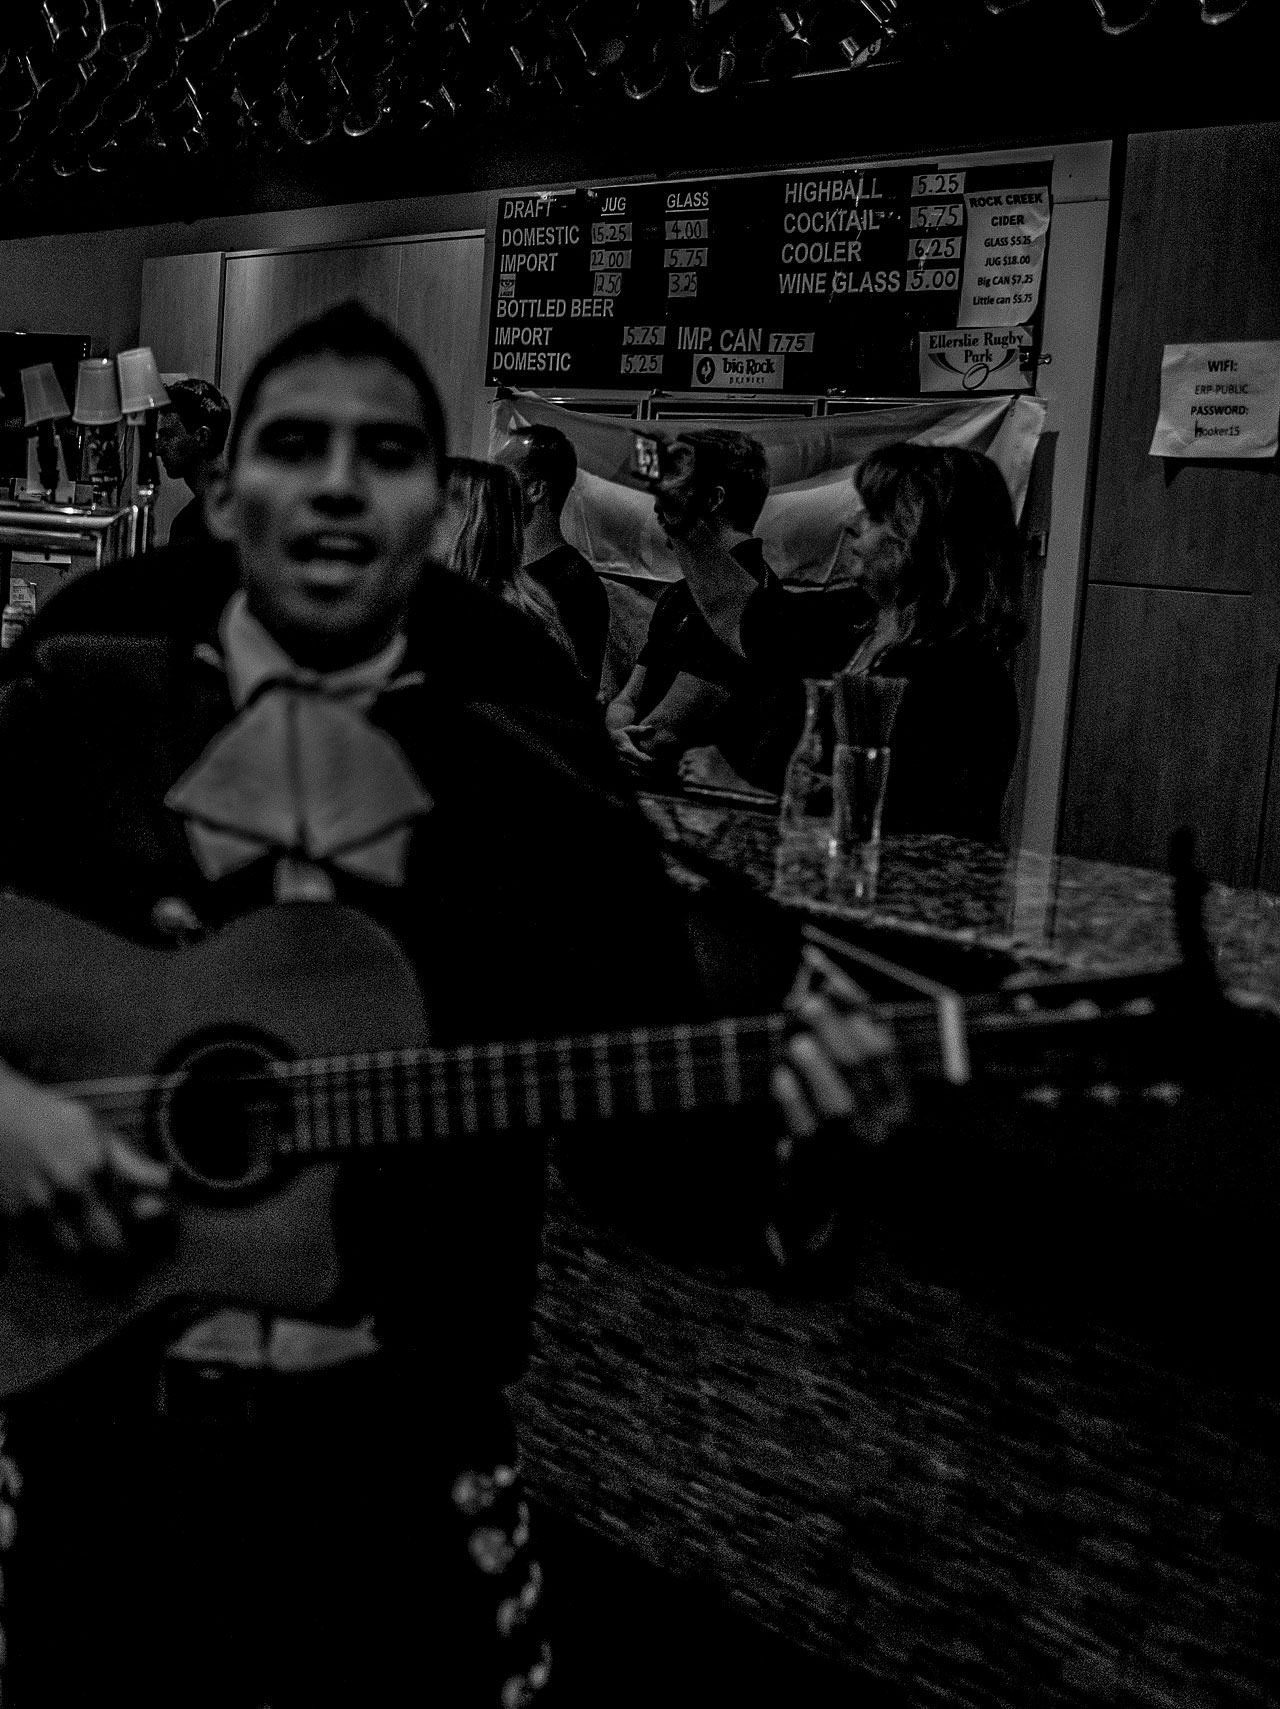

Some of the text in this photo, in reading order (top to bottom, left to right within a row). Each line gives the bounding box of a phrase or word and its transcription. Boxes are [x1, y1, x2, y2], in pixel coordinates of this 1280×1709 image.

[784, 178, 883, 203] HIGHBALL
[918, 175, 960, 194] 5.25
[504, 199, 554, 219] DRAFT
[602, 196, 626, 213] JUG
[666, 192, 709, 208] GLASS
[969, 194, 1042, 207] ROCK CREEK
[784, 209, 880, 233] COCKTAIL
[917, 206, 959, 228] 5.75
[991, 215, 1024, 226] CIDER
[502, 226, 580, 248] DOMESTIC
[592, 226, 626, 242] 15.25
[672, 221, 702, 240] 4.00
[915, 240, 955, 257] 6.25
[984, 236, 1031, 247] GLASS $5.25
[670, 250, 703, 266] 5.75
[781, 241, 862, 263] COOLER
[985, 255, 1030, 266] JUG $18.00
[500, 252, 558, 272] IMPORT
[594, 274, 622, 293] 12.50
[671, 274, 696, 293] 3.25
[779, 270, 901, 294] WINE GLASS
[911, 271, 956, 289] 5.00
[978, 275, 1033, 287] Big CAN $7.25
[496, 299, 614, 318] BOTTLED BEER
[973, 294, 1032, 305] Little can $5.75
[494, 327, 552, 346] IMPORT
[626, 327, 658, 344] 5.75
[678, 327, 762, 352] IMP. CAN
[774, 335, 805, 352] 7.75
[929, 332, 1024, 350] Ellerslie Rugby
[493, 352, 571, 371] DOMESTIC
[625, 354, 658, 372] 5.25
[964, 349, 992, 363] Park
[1208, 360, 1238, 372] WIFI:
[1191, 405, 1248, 415] PASSWORD:
